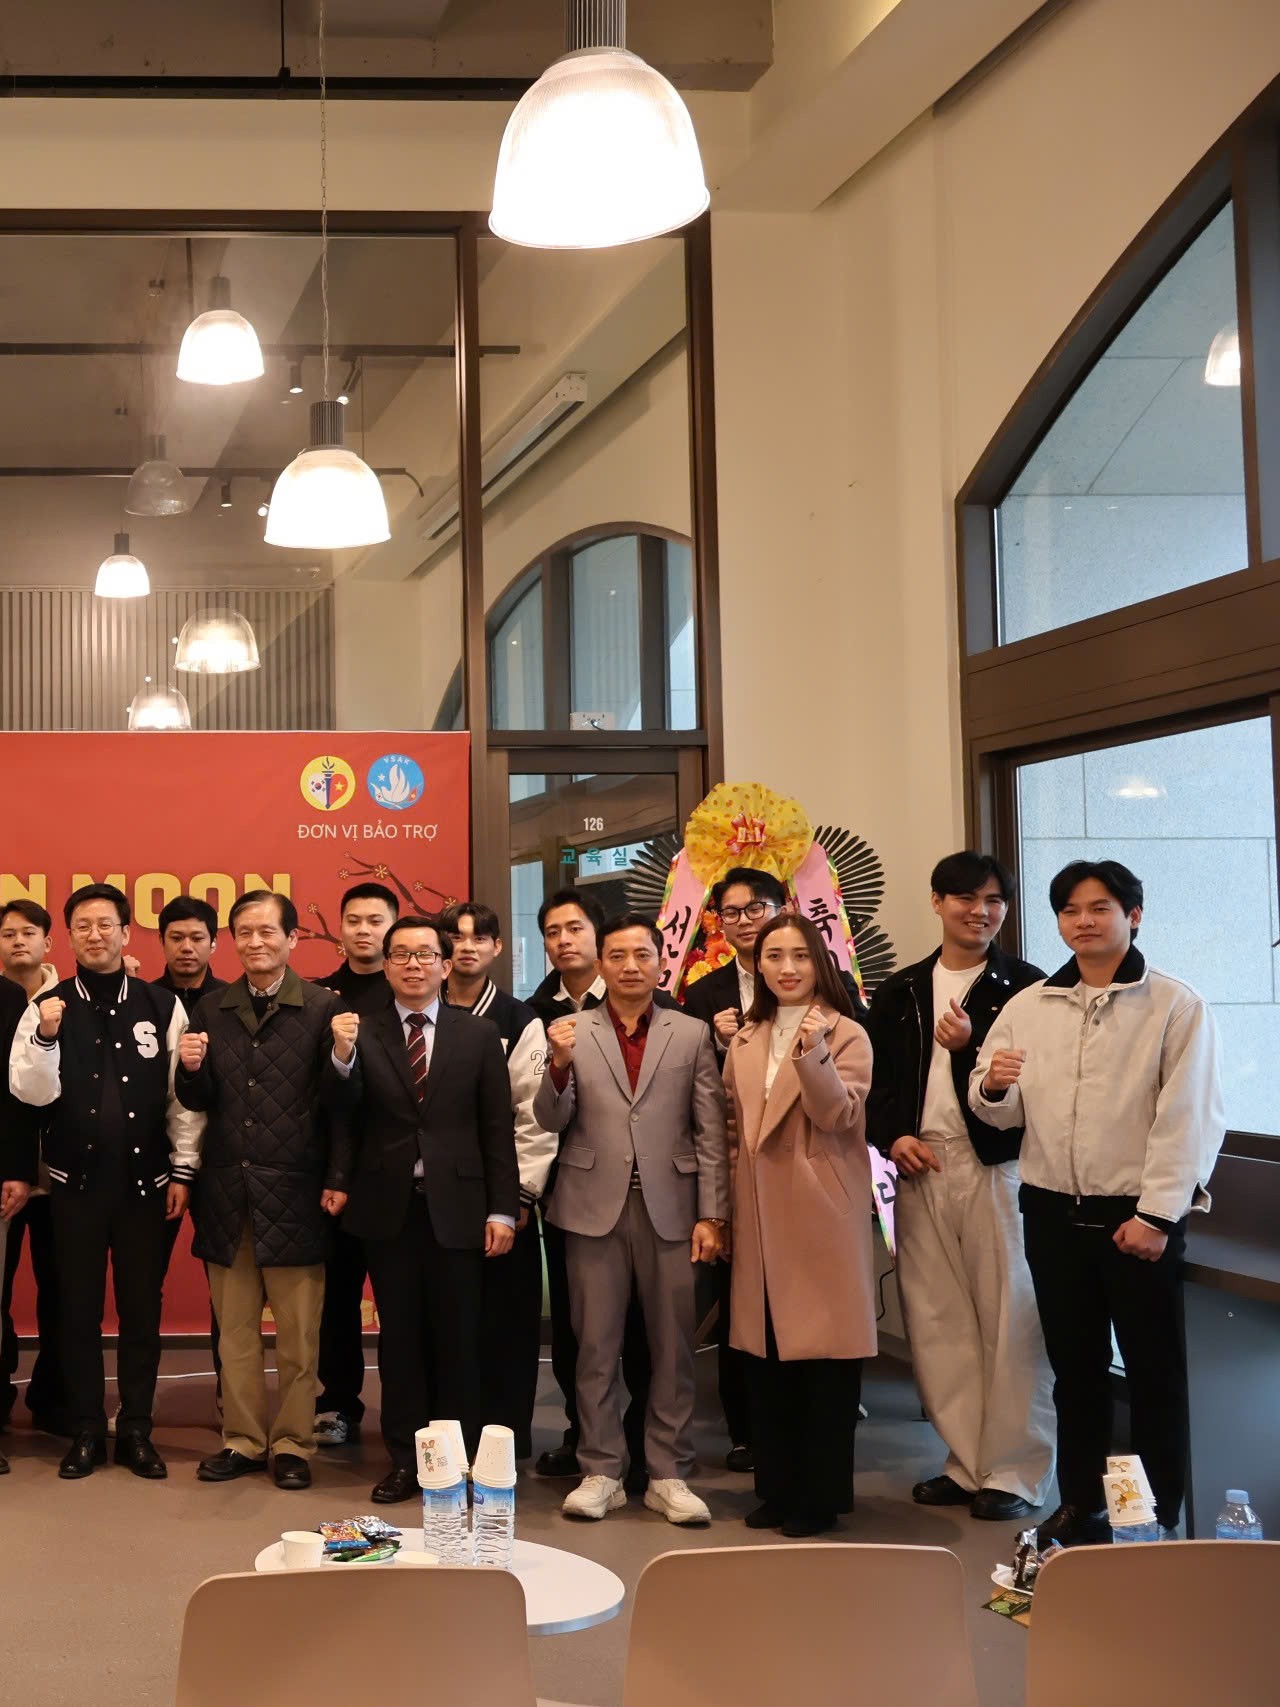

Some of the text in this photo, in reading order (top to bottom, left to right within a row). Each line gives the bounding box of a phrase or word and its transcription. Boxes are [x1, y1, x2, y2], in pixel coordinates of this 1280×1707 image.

[384, 755, 410, 766] VSAK
[298, 819, 438, 842] ĐƠN VỊ BẢO TRỢ
[584, 817, 604, 831] 126
[132, 1020, 160, 1058] S
